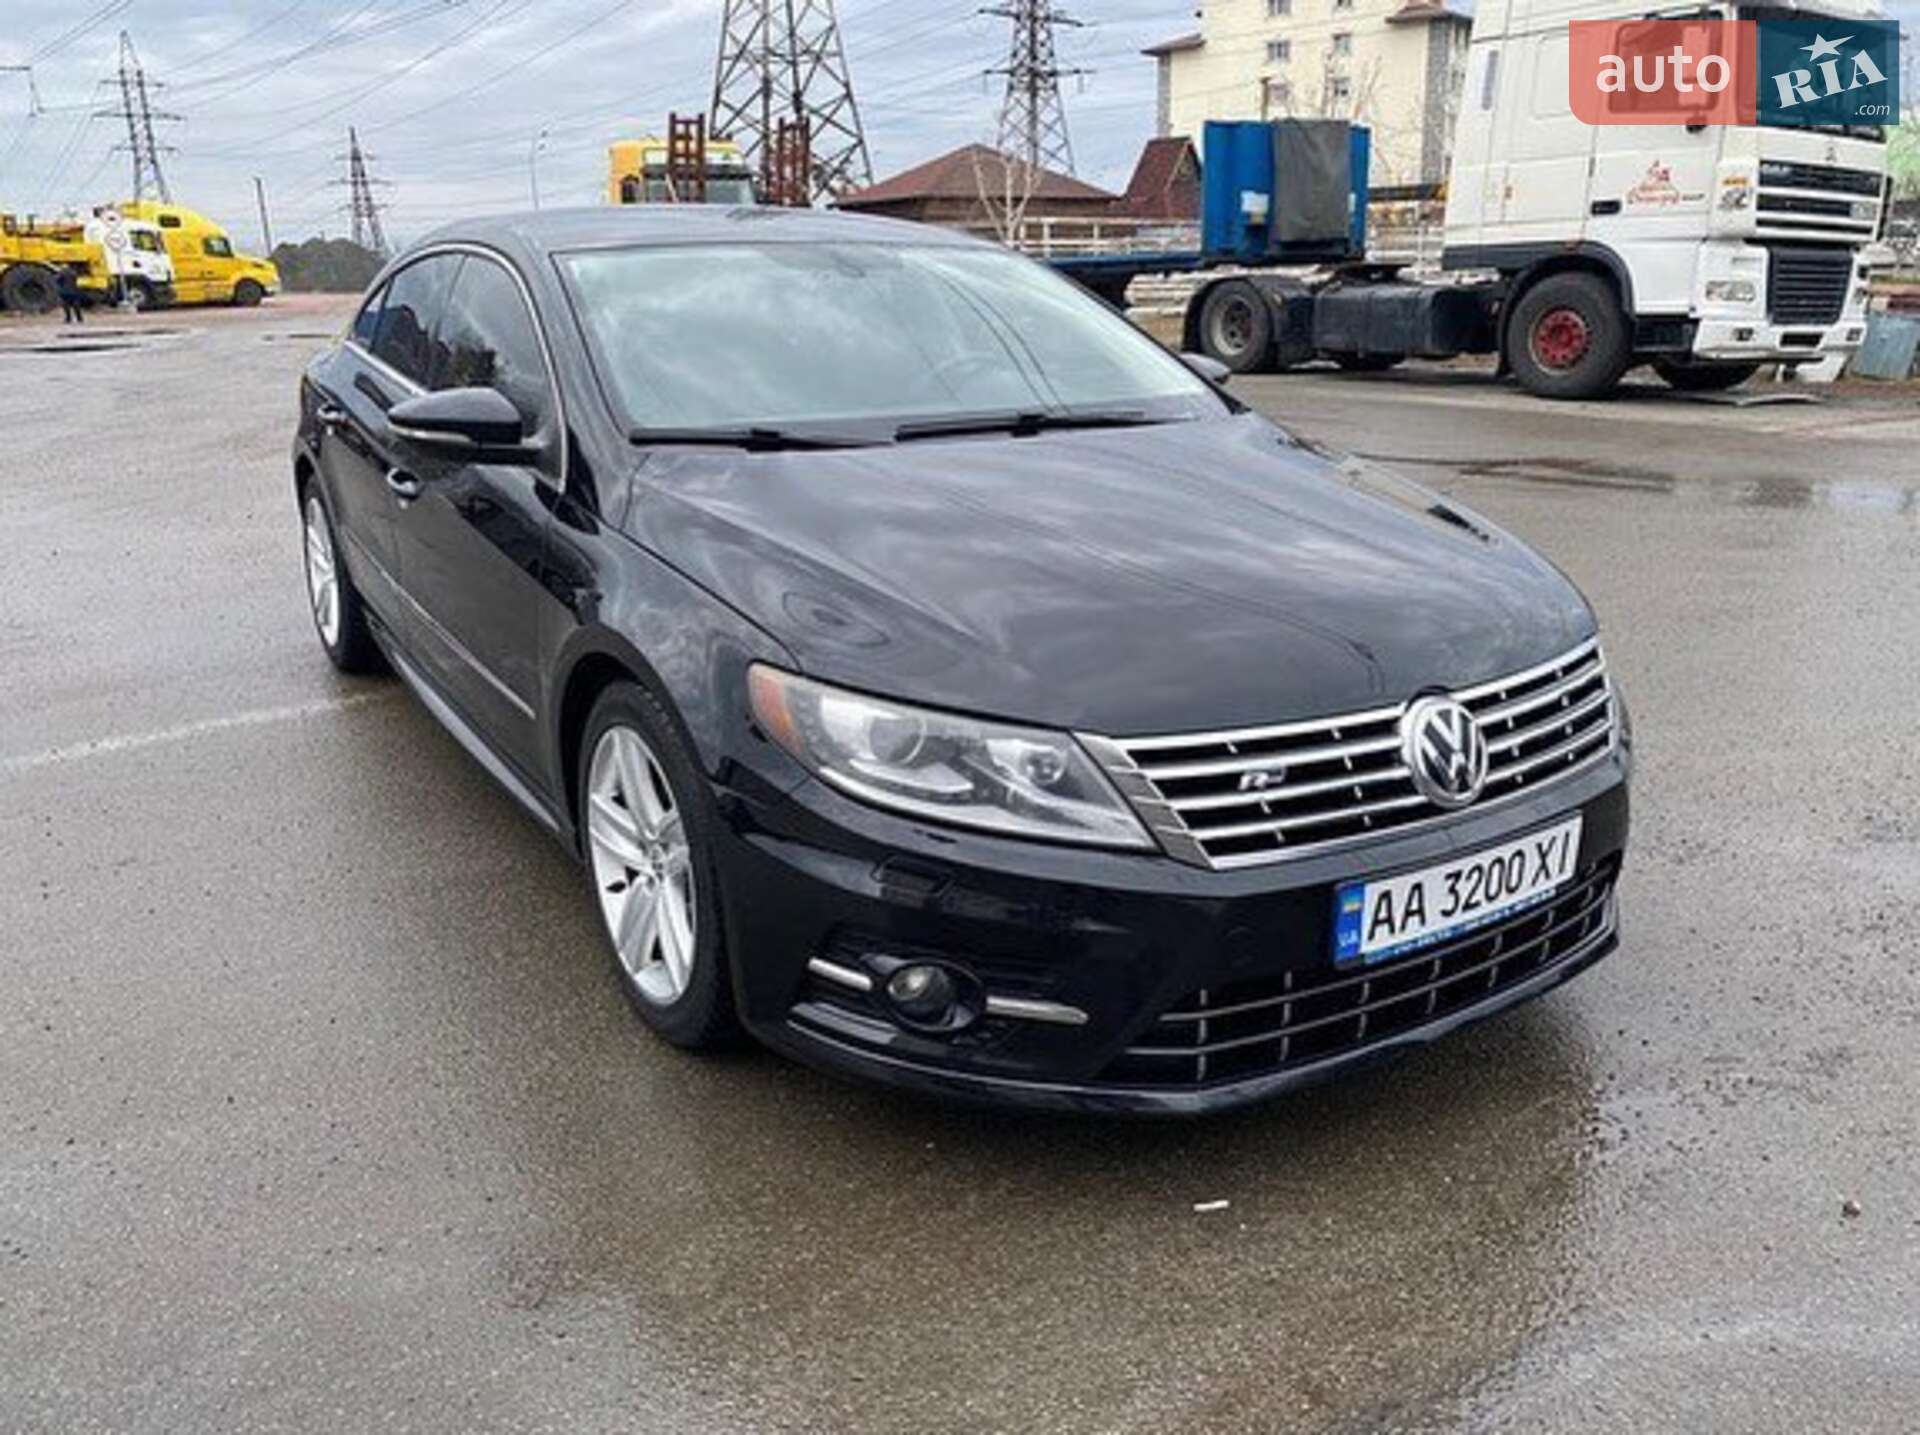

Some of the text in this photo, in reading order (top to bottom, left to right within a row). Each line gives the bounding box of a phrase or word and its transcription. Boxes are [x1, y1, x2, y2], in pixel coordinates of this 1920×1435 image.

[1368, 882, 1426, 940] AA
[1441, 849, 1525, 918] 3200
[1532, 832, 1570, 887] XI
